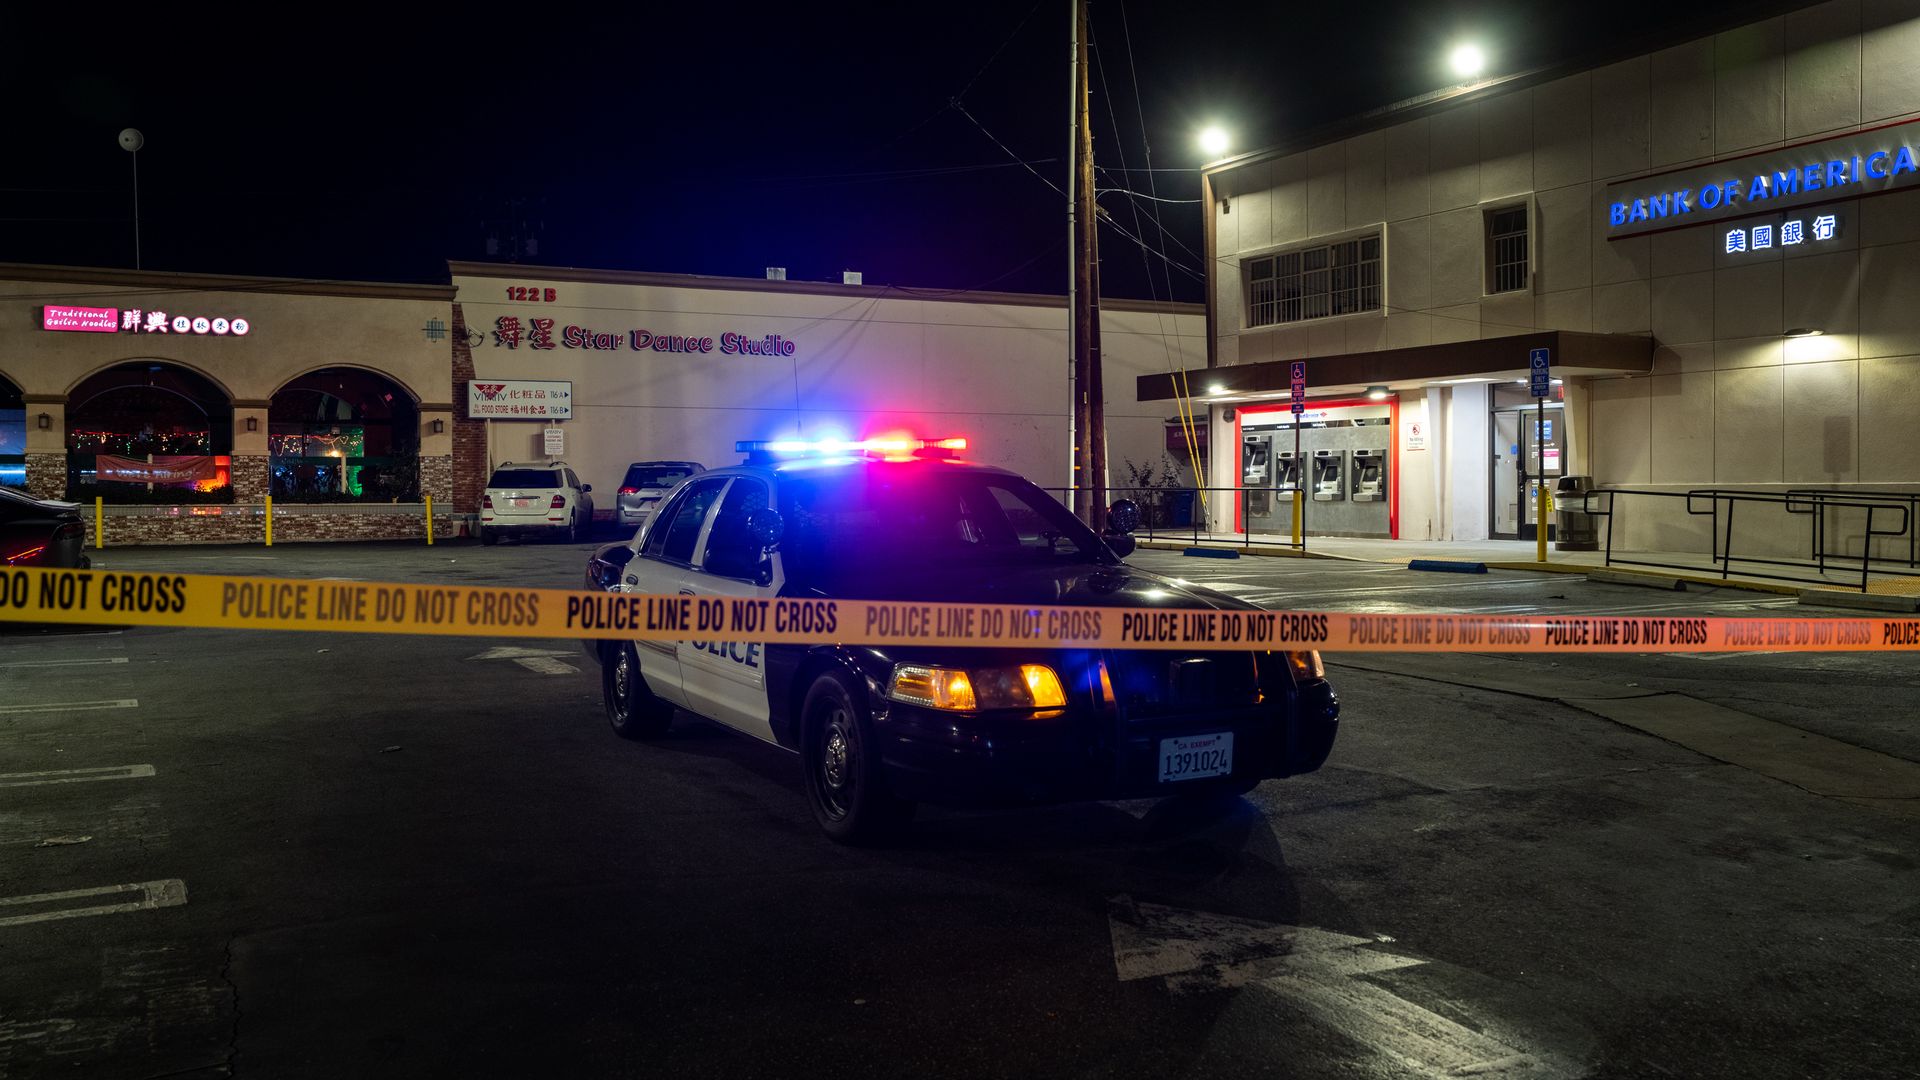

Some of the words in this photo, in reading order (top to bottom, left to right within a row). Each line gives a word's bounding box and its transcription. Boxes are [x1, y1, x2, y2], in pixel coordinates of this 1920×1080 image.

[1610, 189, 1690, 226] BANK
[1700, 180, 1739, 209] OF
[1747, 147, 1917, 202] AMERICA
[1725, 214, 1836, 253] 美國銀行
[507, 286, 540, 301] 122
[544, 287, 557, 302] B
[50, 309, 109, 318] Traditional
[81, 320, 117, 328] Noodles
[498, 315, 556, 350] 舞星
[565, 324, 624, 350] Star
[632, 329, 714, 353] Dance
[722, 332, 796, 356] Studio
[481, 405, 494, 413] FOOD
[495, 405, 509, 414] STORE
[39, 572, 92, 610] NOT
[101, 574, 187, 613] CROSS
[222, 582, 307, 620] POLICE
[316, 585, 368, 621] LINE
[376, 588, 405, 623] DO
[414, 589, 459, 624] NOT
[467, 591, 540, 627] CROSS
[567, 596, 640, 630] POLICE
[646, 598, 690, 631] LINE
[698, 599, 724, 632] DO
[731, 600, 769, 633] NOT
[775, 601, 838, 634] CROSS
[866, 605, 930, 637] POLICE
[936, 607, 975, 638] LINE
[980, 608, 1002, 639] DO
[1009, 609, 1042, 639] NOT
[1048, 609, 1102, 640] CROSS
[1122, 613, 1178, 642] POLICE
[1183, 613, 1216, 642] LINE
[1221, 613, 1241, 642] DO
[1246, 613, 1275, 642] NOT
[1280, 613, 1328, 642] CROSS
[1349, 617, 1398, 644] POLICE
[1402, 617, 1431, 645] LINE
[1436, 618, 1454, 645] DO
[1458, 618, 1485, 645] NOT
[1488, 618, 1531, 645] CROSS
[1545, 620, 1589, 646] POLICE
[1593, 620, 1619, 645] LINE
[1623, 620, 1639, 645] DO
[1643, 620, 1665, 645] NOT
[1669, 620, 1707, 645] CROSS
[1724, 622, 1764, 646] POLICE
[1768, 622, 1791, 646] LINE
[1794, 622, 1809, 646] DO
[1813, 622, 1834, 645] NOT
[1837, 622, 1871, 645] CROSS
[1883, 621, 1919, 645] POLICE
[679, 640, 759, 668] LICE
[1164, 749, 1227, 775] 1391024
